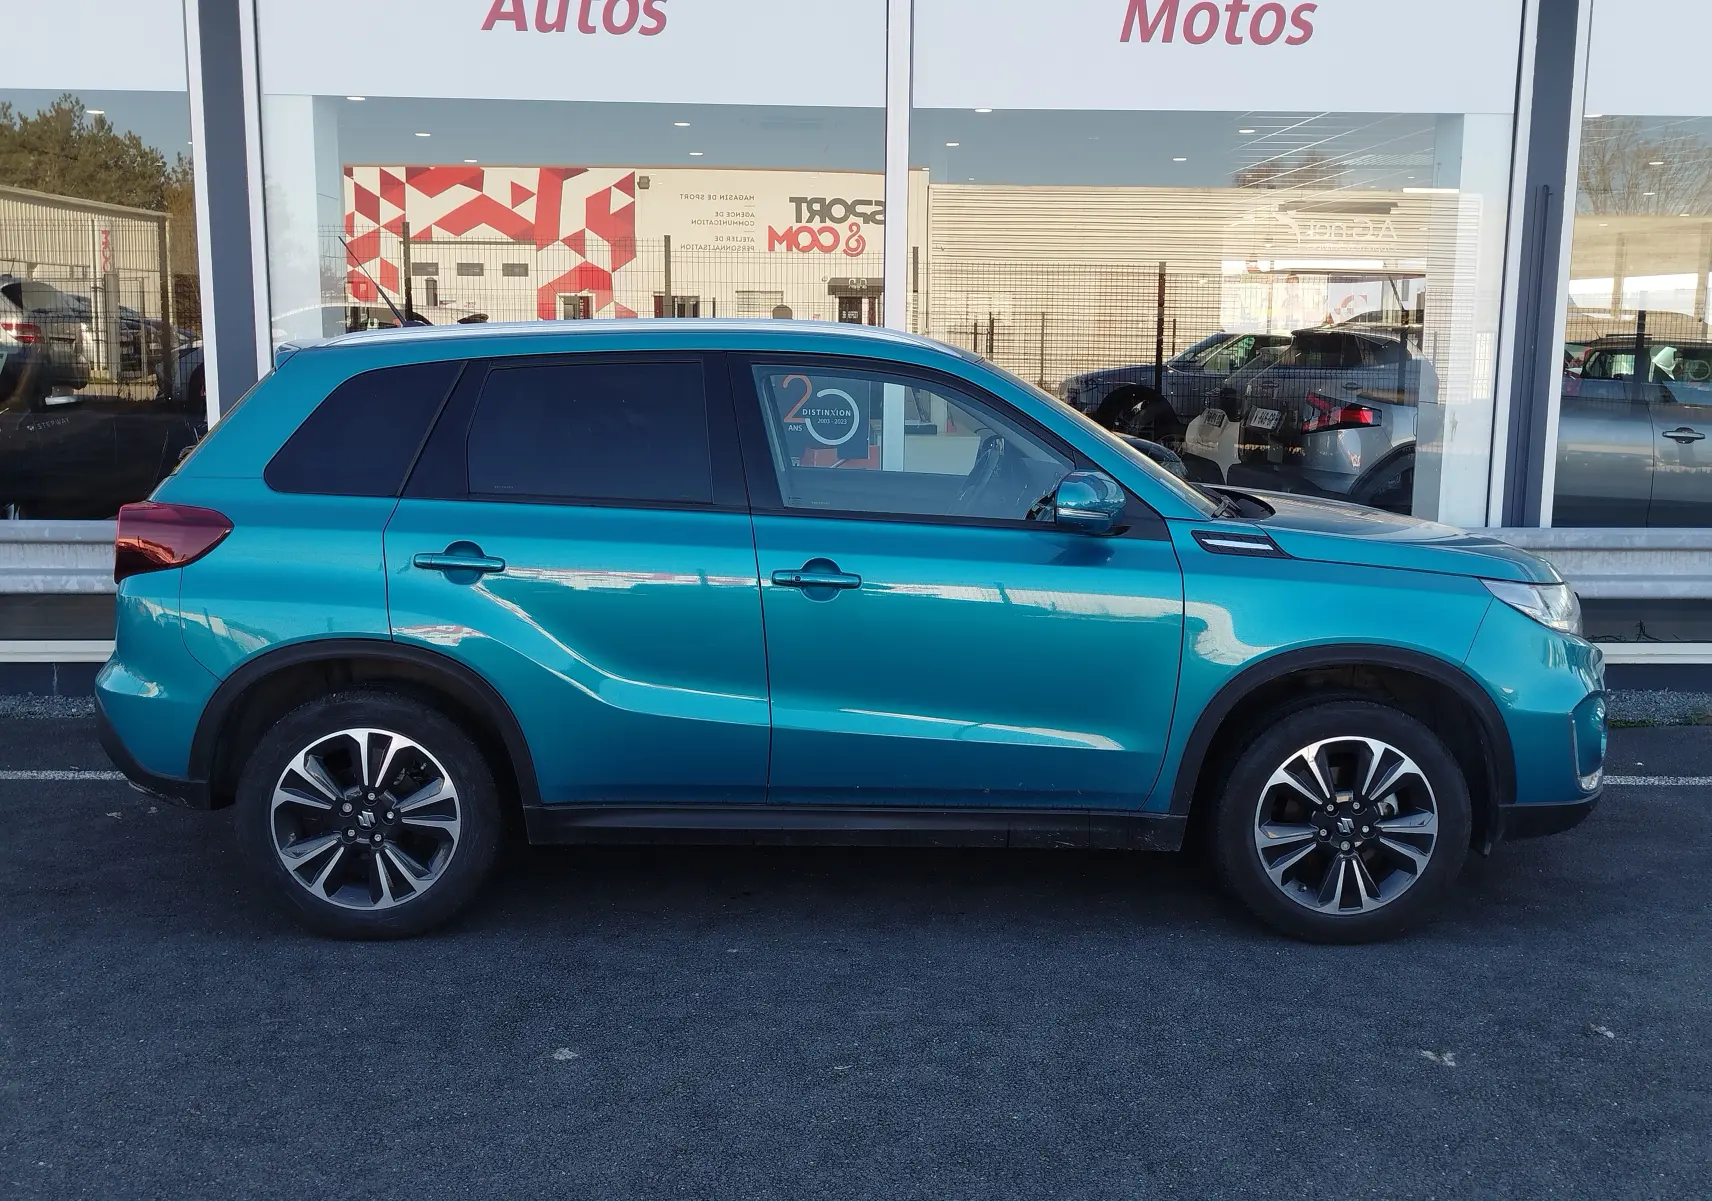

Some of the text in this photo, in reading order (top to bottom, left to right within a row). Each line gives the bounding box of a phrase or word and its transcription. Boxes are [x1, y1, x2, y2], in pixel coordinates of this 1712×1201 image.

[480, 0, 668, 36] Autos
[1119, 0, 1318, 45] Motos
[802, 408, 851, 417] DISTINXION
[788, 424, 803, 432] ANS
